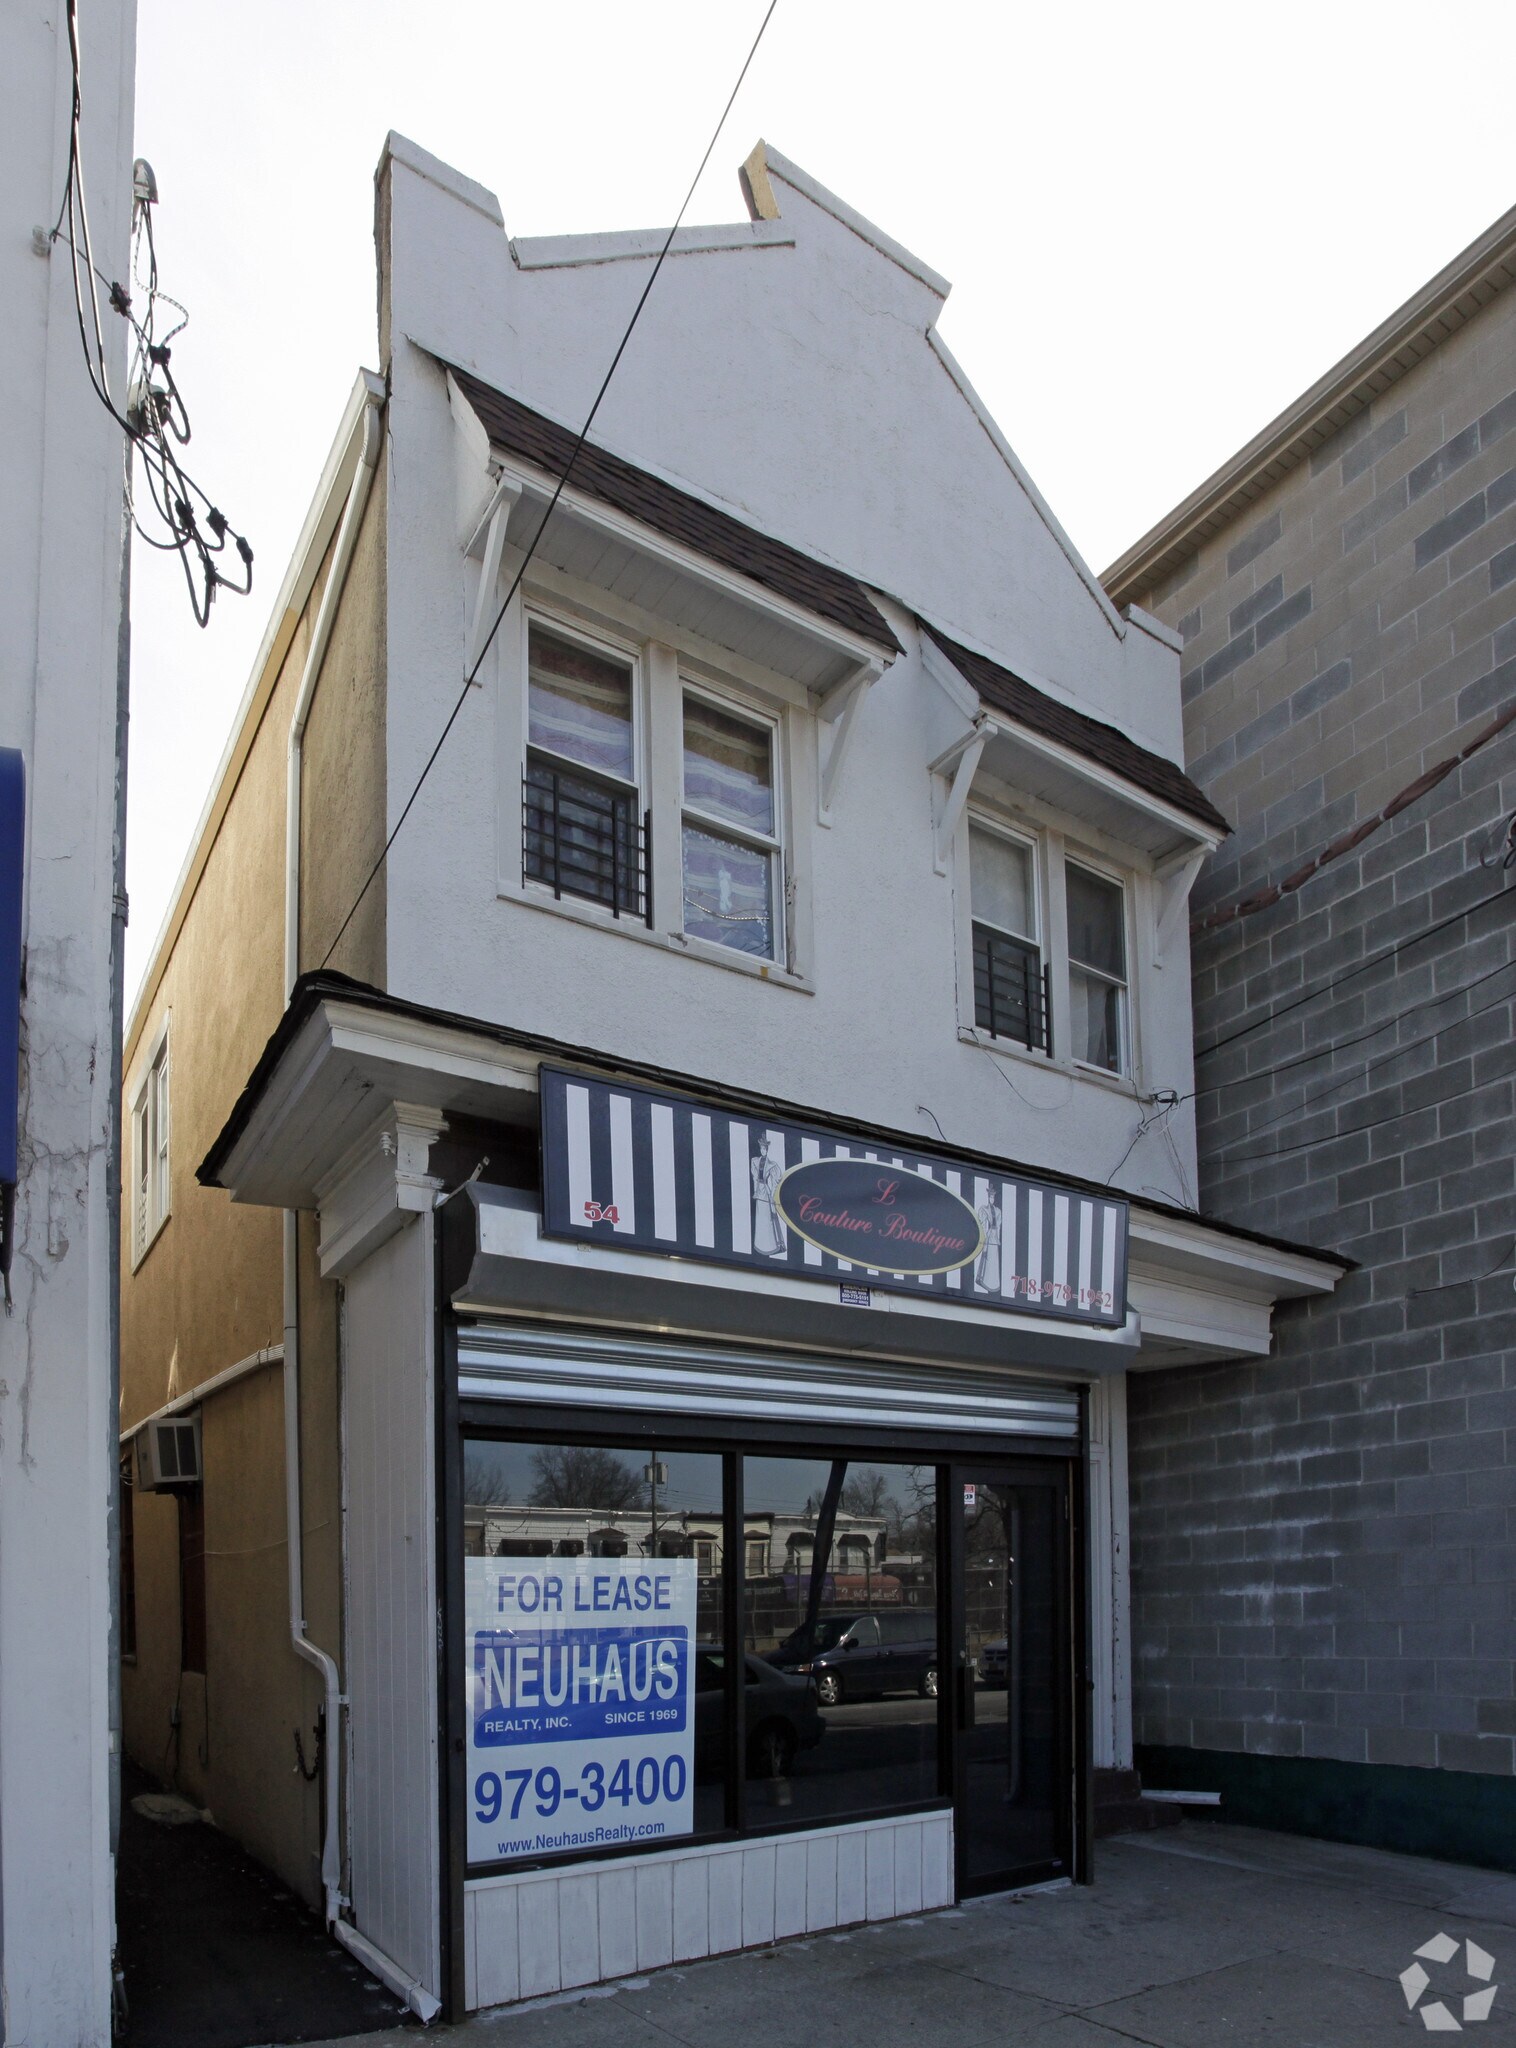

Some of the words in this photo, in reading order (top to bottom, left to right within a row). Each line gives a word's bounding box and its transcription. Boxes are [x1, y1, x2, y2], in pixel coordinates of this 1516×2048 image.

[872, 1178, 899, 1206] L
[583, 1201, 620, 1224] 54
[798, 1194, 873, 1234] Couture
[878, 1213, 965, 1254] Boutique
[1011, 1275, 1112, 1308] 718-978-1952
[498, 1575, 563, 1613] FOR
[574, 1575, 671, 1612] LEASE
[484, 1641, 678, 1710] NEUHAUS
[484, 1718, 541, 1733] REALTY,
[545, 1716, 572, 1728] INC.
[604, 1711, 645, 1724] SINCE
[649, 1709, 678, 1721] 1969
[474, 1754, 686, 1824] 979-3400
[497, 1822, 665, 1854] www.NeuhausRealty.com
